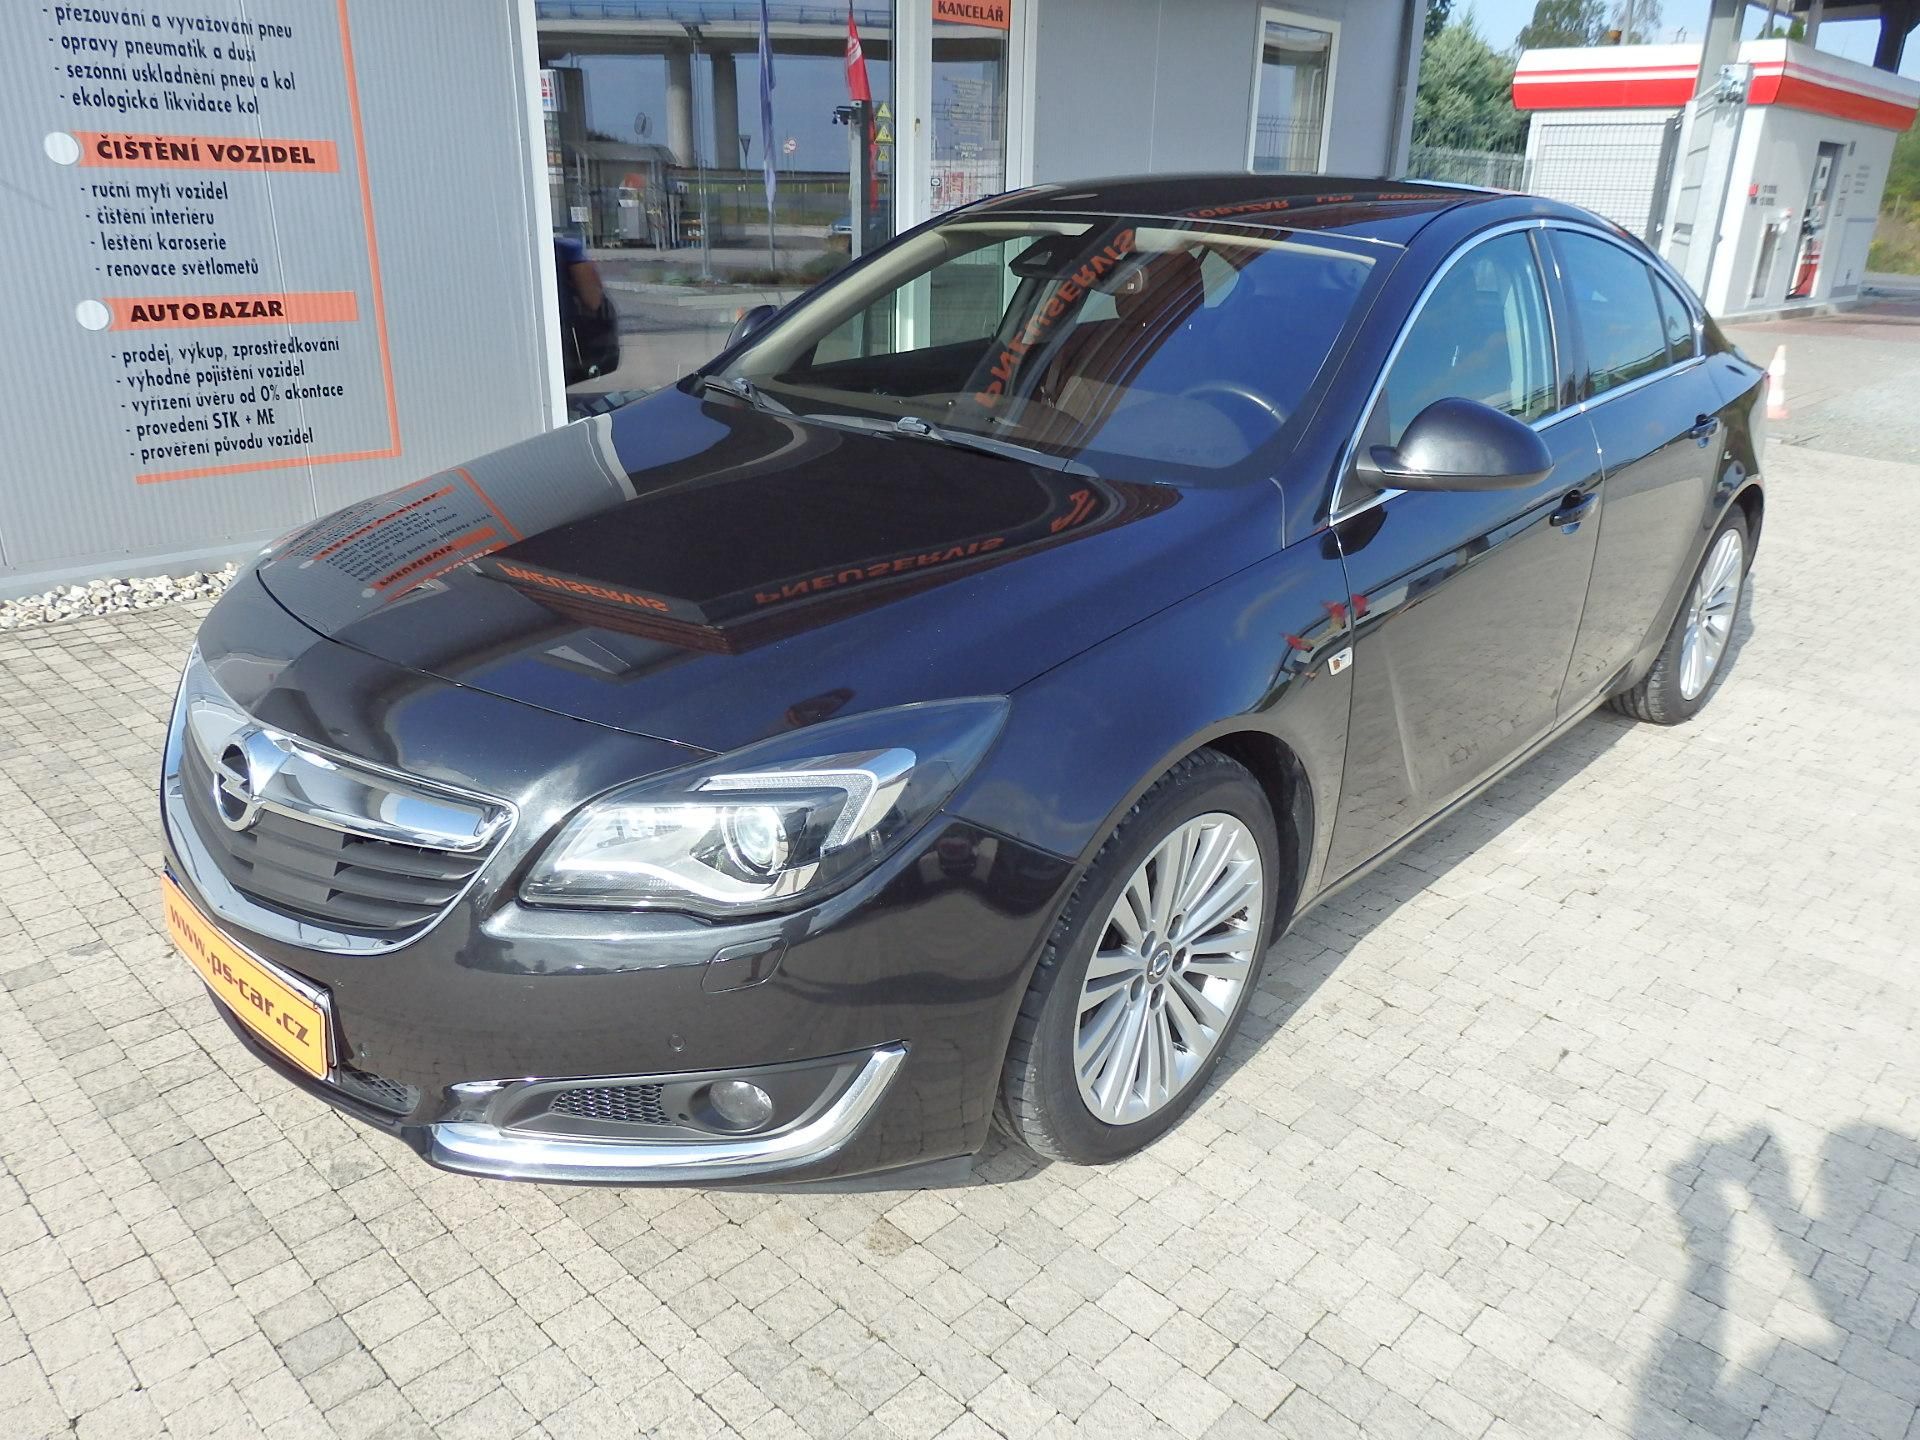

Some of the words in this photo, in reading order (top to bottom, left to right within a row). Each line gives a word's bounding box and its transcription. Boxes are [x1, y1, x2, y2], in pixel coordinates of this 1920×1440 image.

[55, 2, 146, 27] přezouvání
[151, 14, 161, 28] a
[167, 15, 253, 35] vyvažování
[258, 22, 293, 41] pneu
[937, 0, 1004, 22] KANCELÁŘ
[61, 35, 118, 58] opravy
[124, 38, 207, 58] pneumatik
[213, 46, 223, 59] a
[67, 61, 127, 81] sezónní
[132, 62, 216, 86] uskladnění
[221, 73, 255, 91] pneu
[260, 75, 269, 89] a
[273, 71, 296, 90] kol
[72, 86, 158, 113] ekologická
[163, 91, 233, 112] likvidace
[236, 95, 260, 114] kol
[97, 134, 200, 162] ČIŠTĚNÍ
[207, 143, 316, 164] VOZIDEL
[91, 180, 131, 199] ruční
[176, 181, 228, 200] vozidel
[97, 205, 147, 225] čištění
[101, 231, 153, 251] leštění
[157, 232, 227, 250] karoserie
[107, 262, 176, 277] renovace
[182, 257, 260, 276] světlometů
[130, 300, 285, 322] AUTOBAZAR
[122, 343, 174, 368] prodej,
[232, 335, 340, 359] zprostředkování
[127, 368, 191, 392] výhodné
[196, 364, 254, 388] pojištění
[258, 359, 306, 379] vozidel
[132, 393, 192, 416] vyřízení
[196, 389, 236, 408] úvěru
[240, 386, 256, 403] od
[260, 384, 281, 401] 0%
[285, 382, 344, 400] akontace
[137, 415, 209, 441] provedení
[213, 411, 241, 430] STK
[257, 408, 276, 426] ME
[141, 438, 211, 464] prověření
[214, 435, 264, 457] původu
[267, 426, 314, 448] vozidel
